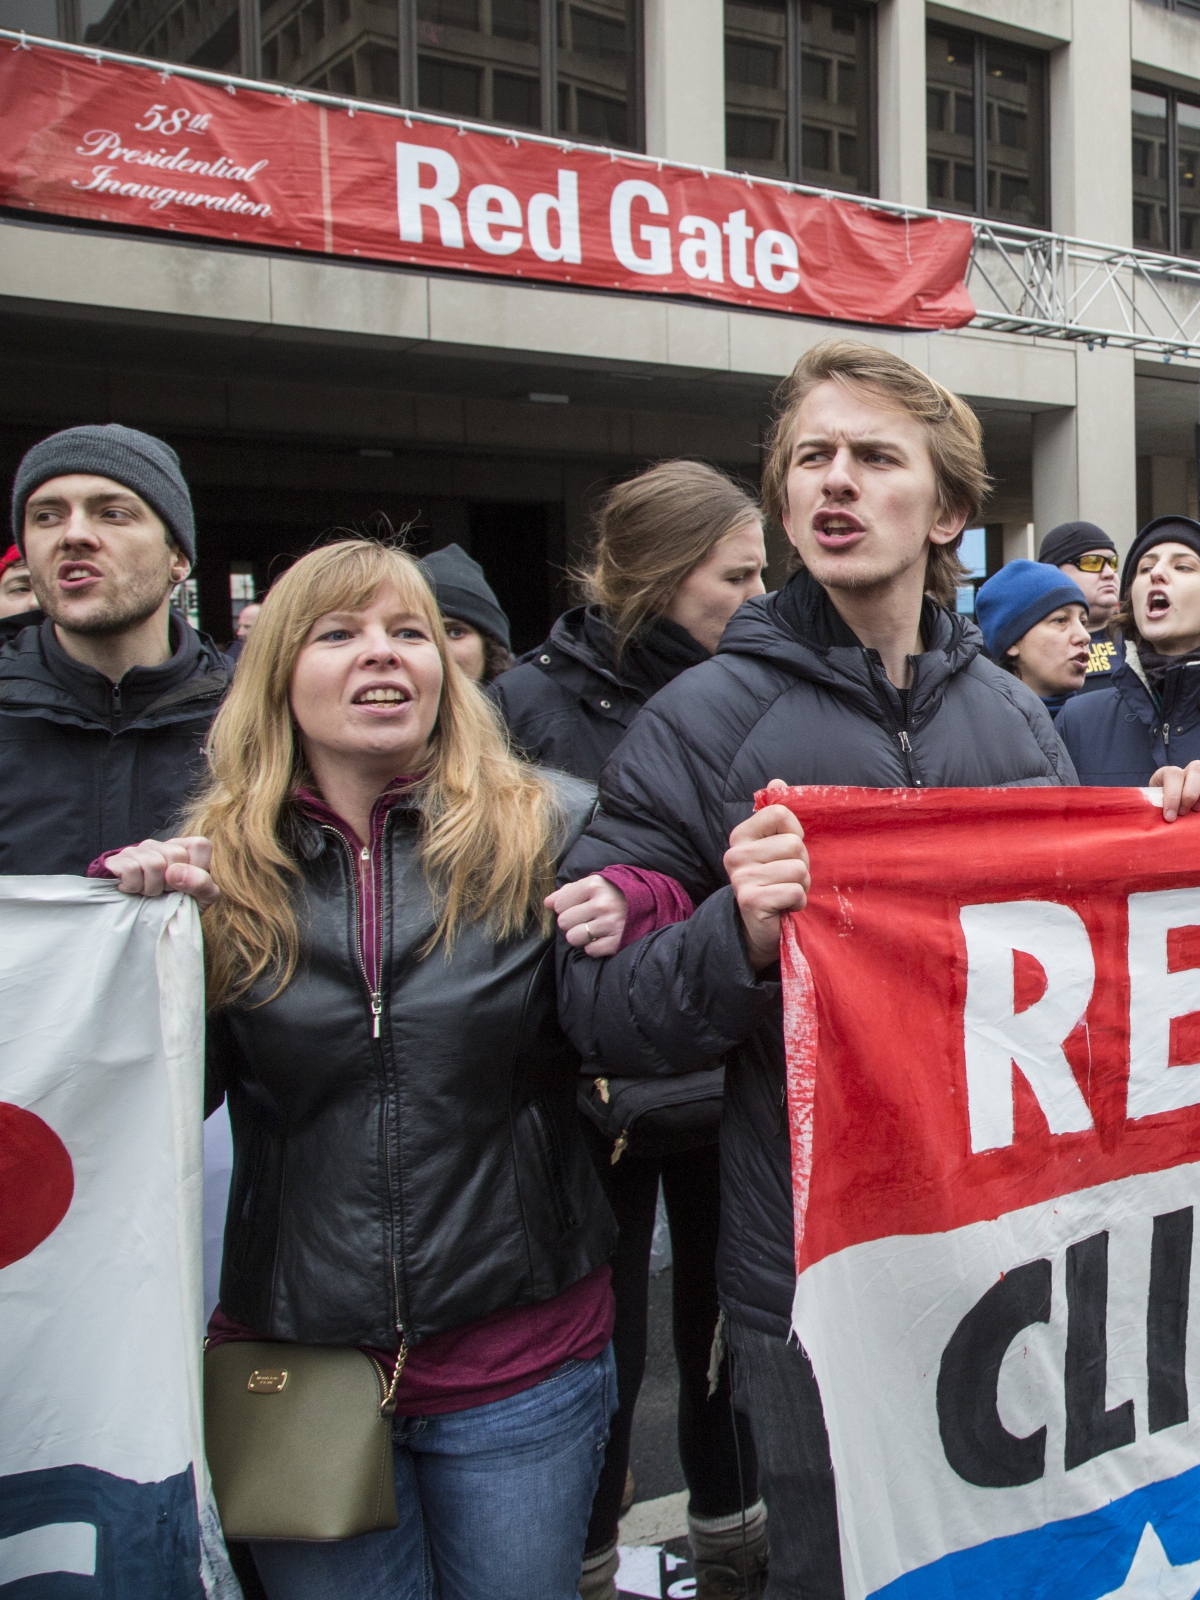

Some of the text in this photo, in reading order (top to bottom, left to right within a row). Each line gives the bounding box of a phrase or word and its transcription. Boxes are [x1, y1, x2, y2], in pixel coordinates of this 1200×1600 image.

[134, 103, 213, 136] 58th
[75, 128, 269, 183] Presidential
[70, 164, 273, 218] Inauguration
[396, 141, 800, 294] Red Gate
[1087, 641, 1118, 658] LICE
